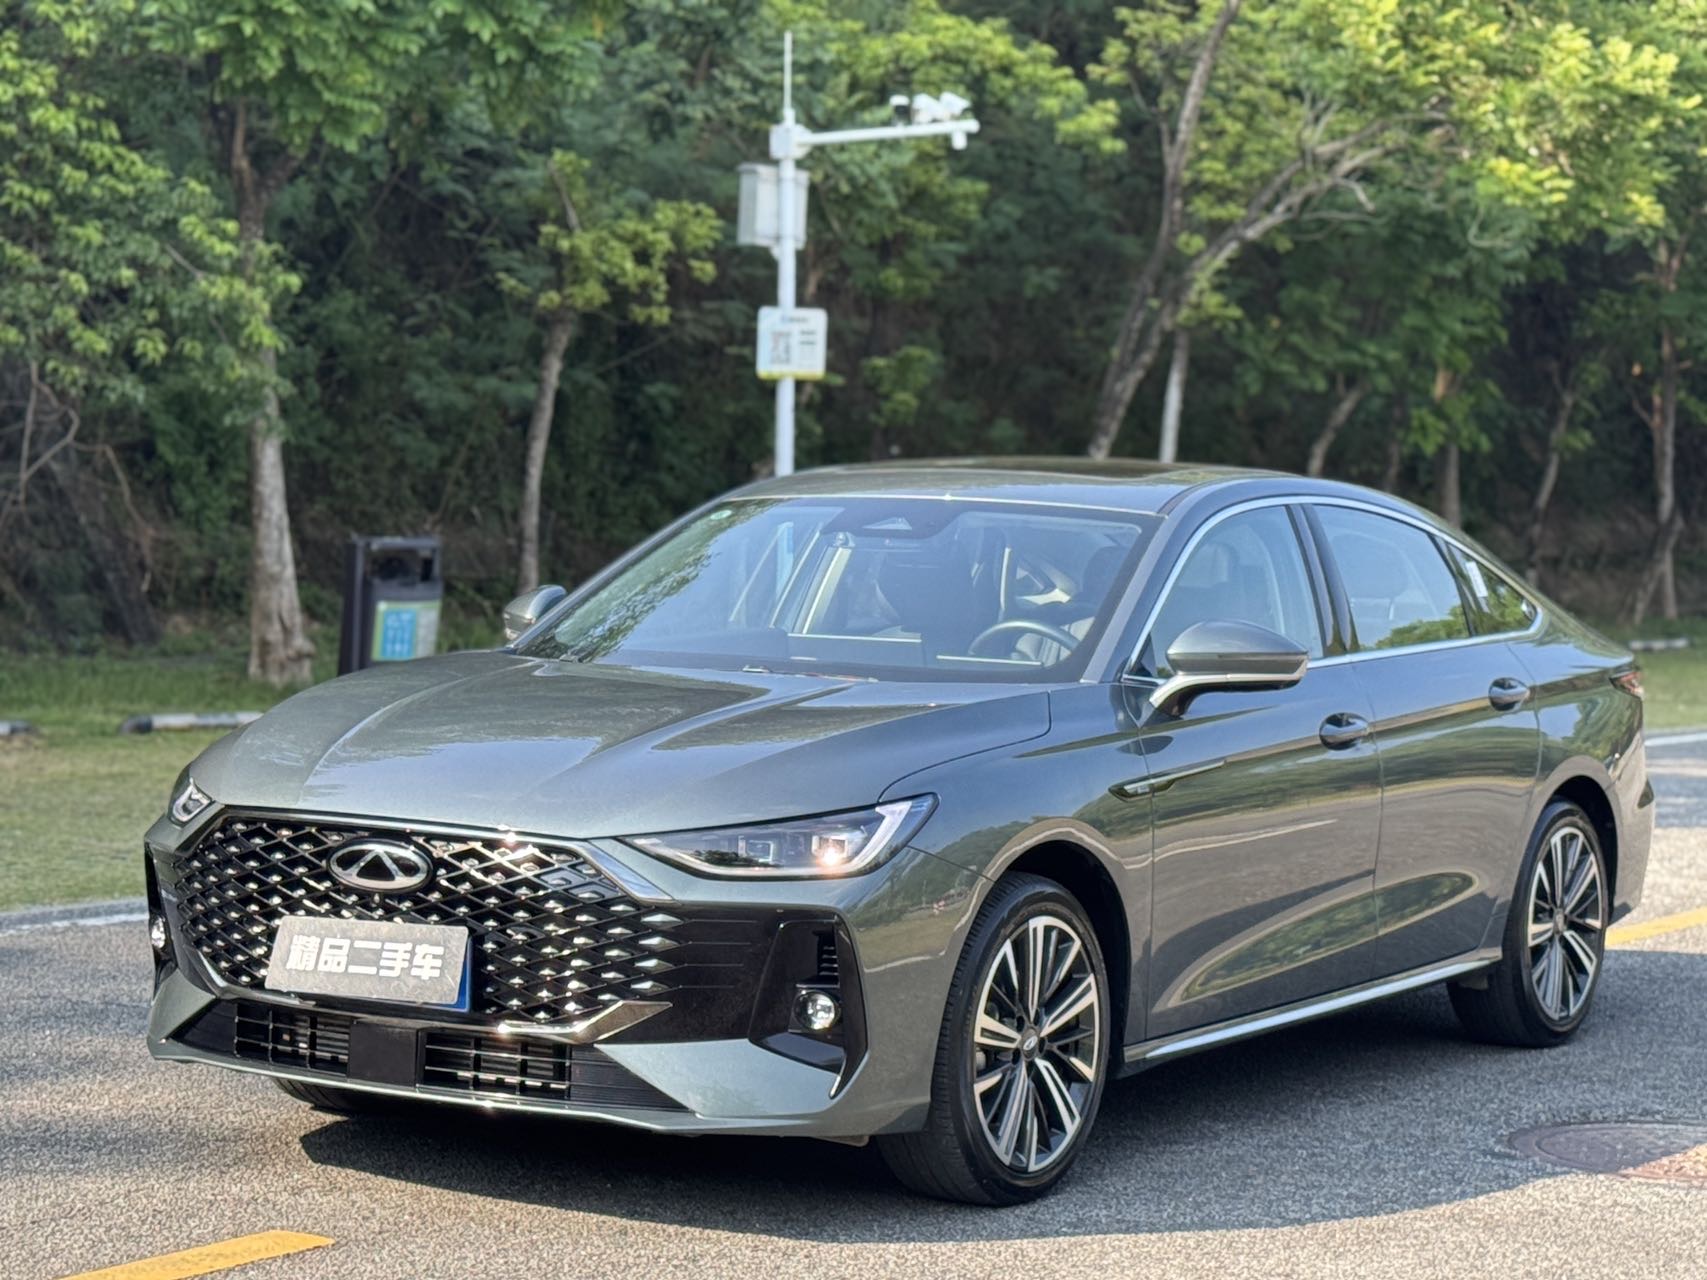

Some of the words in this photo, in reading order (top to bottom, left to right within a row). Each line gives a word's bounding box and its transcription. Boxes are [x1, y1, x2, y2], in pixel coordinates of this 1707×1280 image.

[285, 934, 445, 980] 精品二手车
